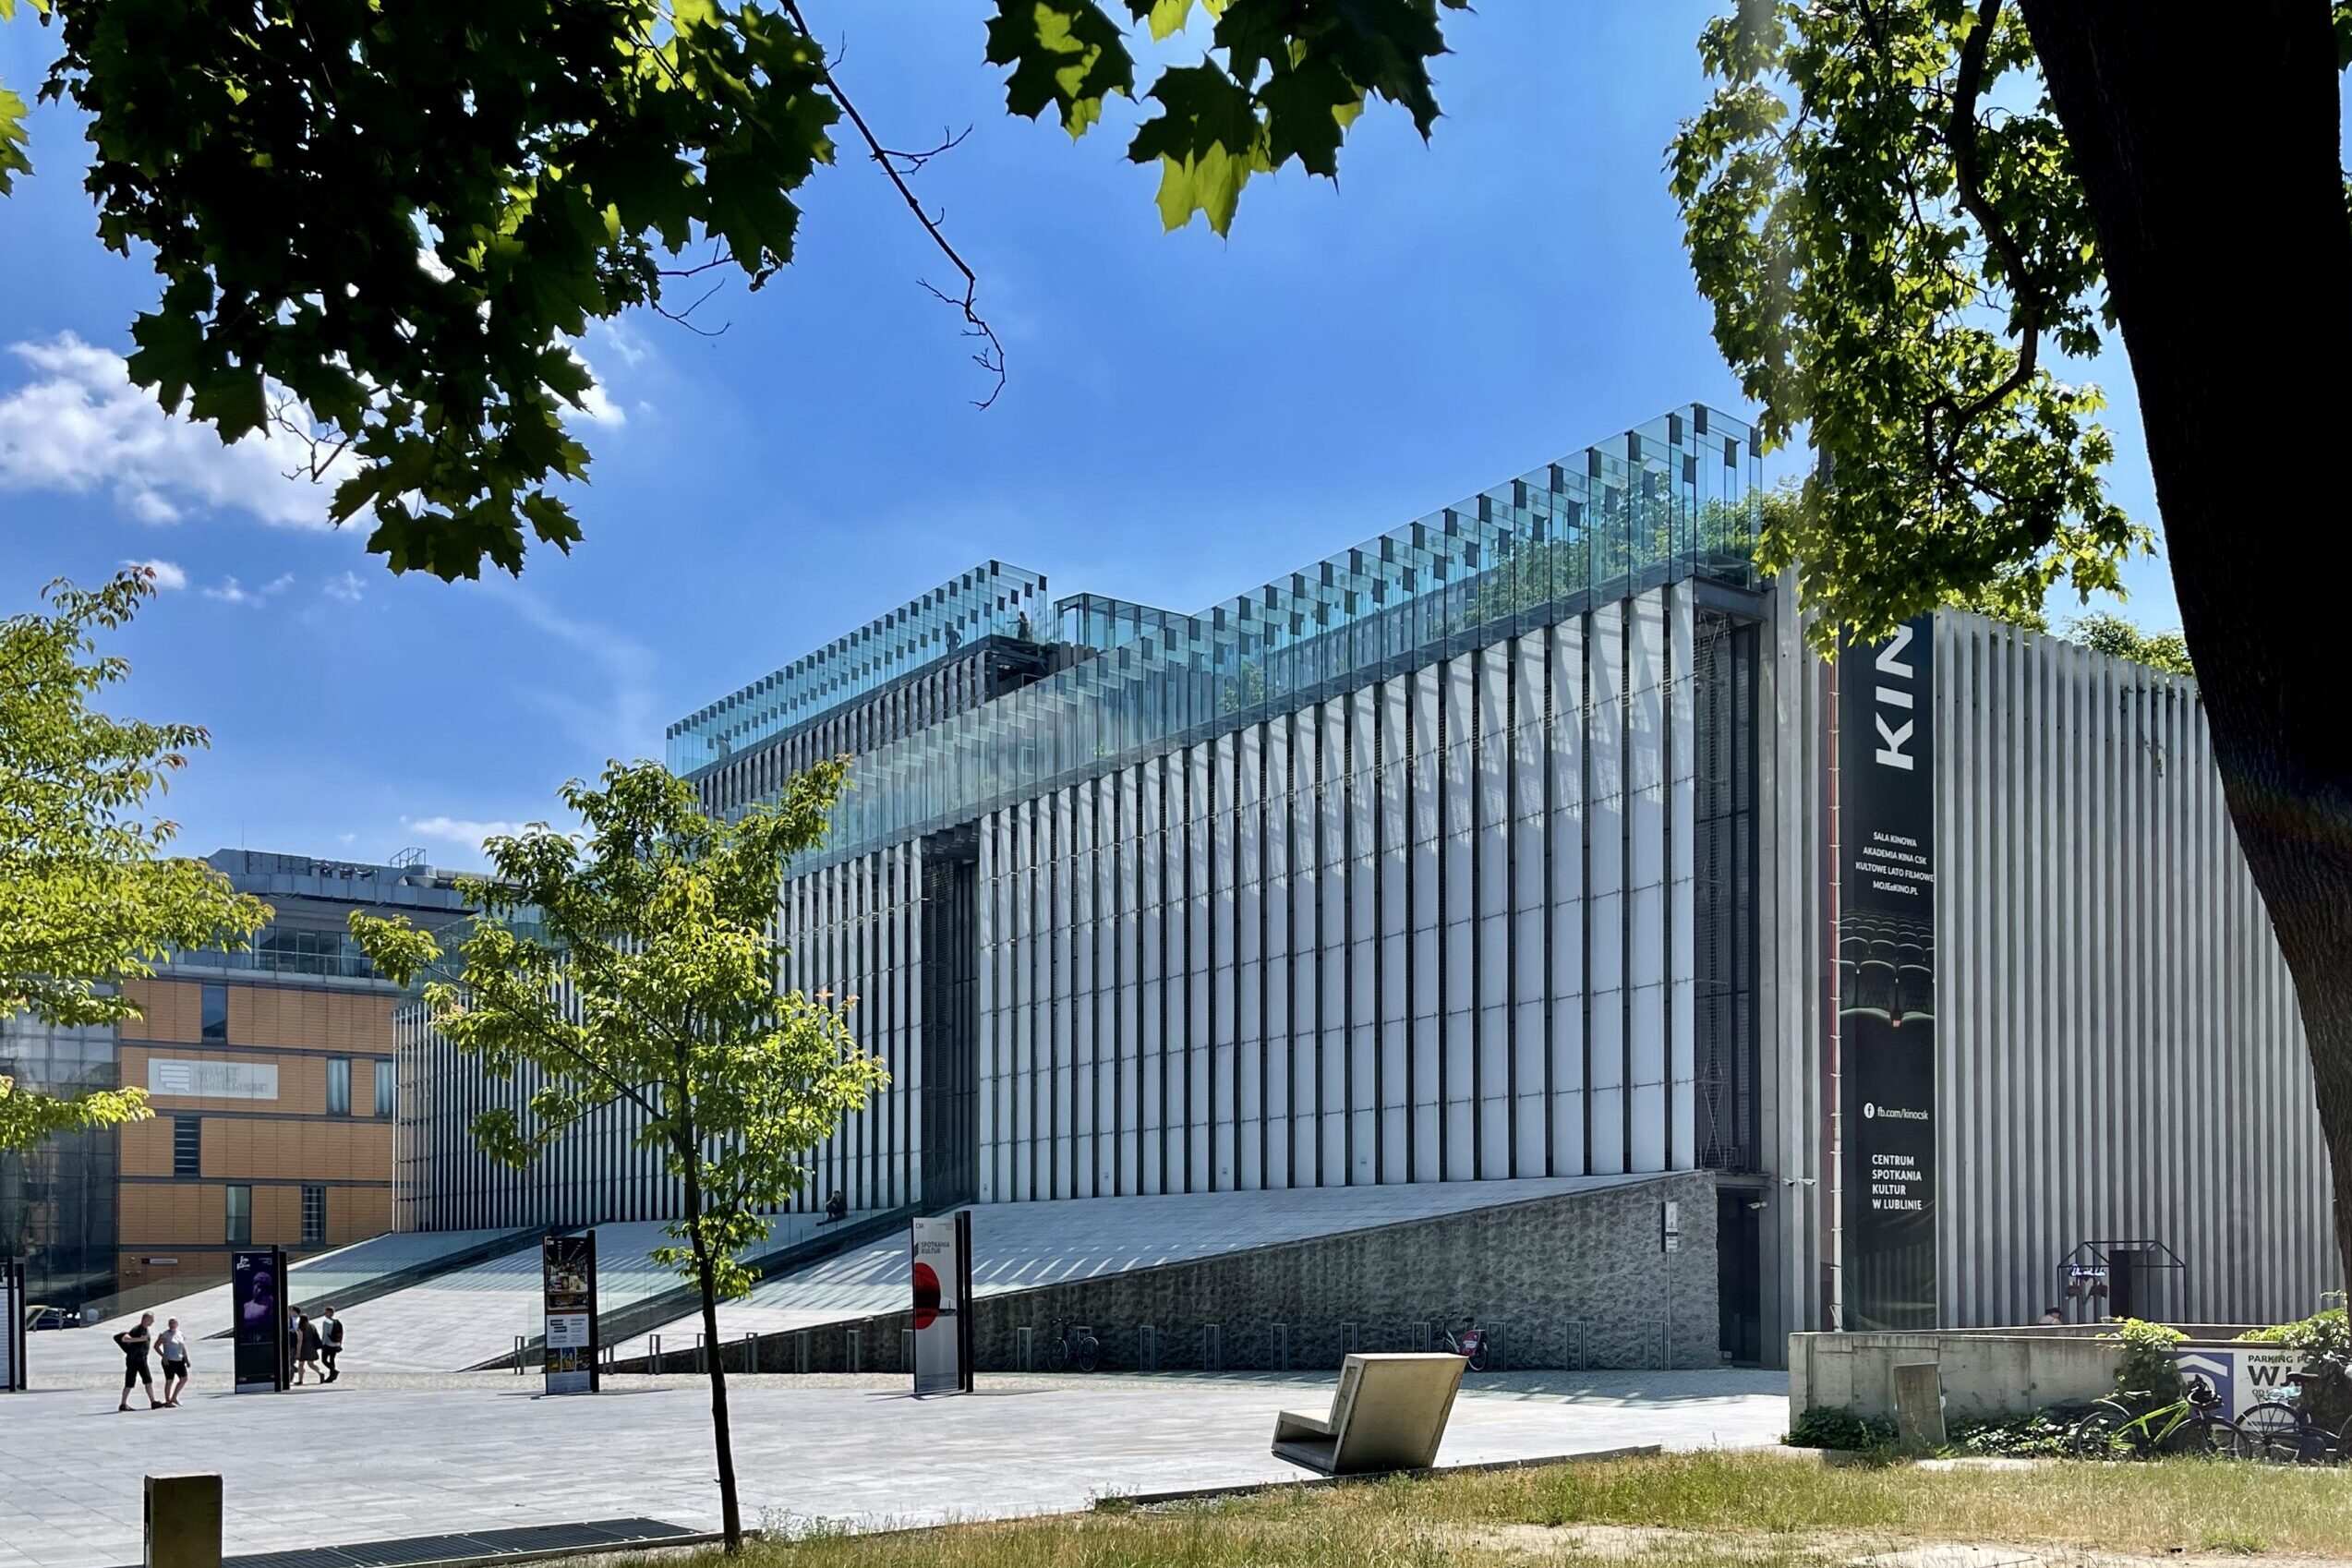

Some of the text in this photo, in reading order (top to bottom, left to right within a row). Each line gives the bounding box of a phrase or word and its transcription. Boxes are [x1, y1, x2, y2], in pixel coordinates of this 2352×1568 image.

[1873, 831, 1917, 847] SALA KINOWA
[1863, 846, 1927, 864] AKADEMIA KINA CSK
[1855, 861, 1935, 882] KULTOWE LATO FILMOWE
[1877, 1106, 1928, 1120] fb.com/kinocsk
[1872, 1154, 1914, 1166] CENTRUM
[1872, 1169, 1922, 1181] SPOTKANIA
[1872, 1184, 1906, 1195] KULTUR
[1872, 1199, 1923, 1211] W LUBLINIE
[2248, 1355, 2294, 1363] PARKING
